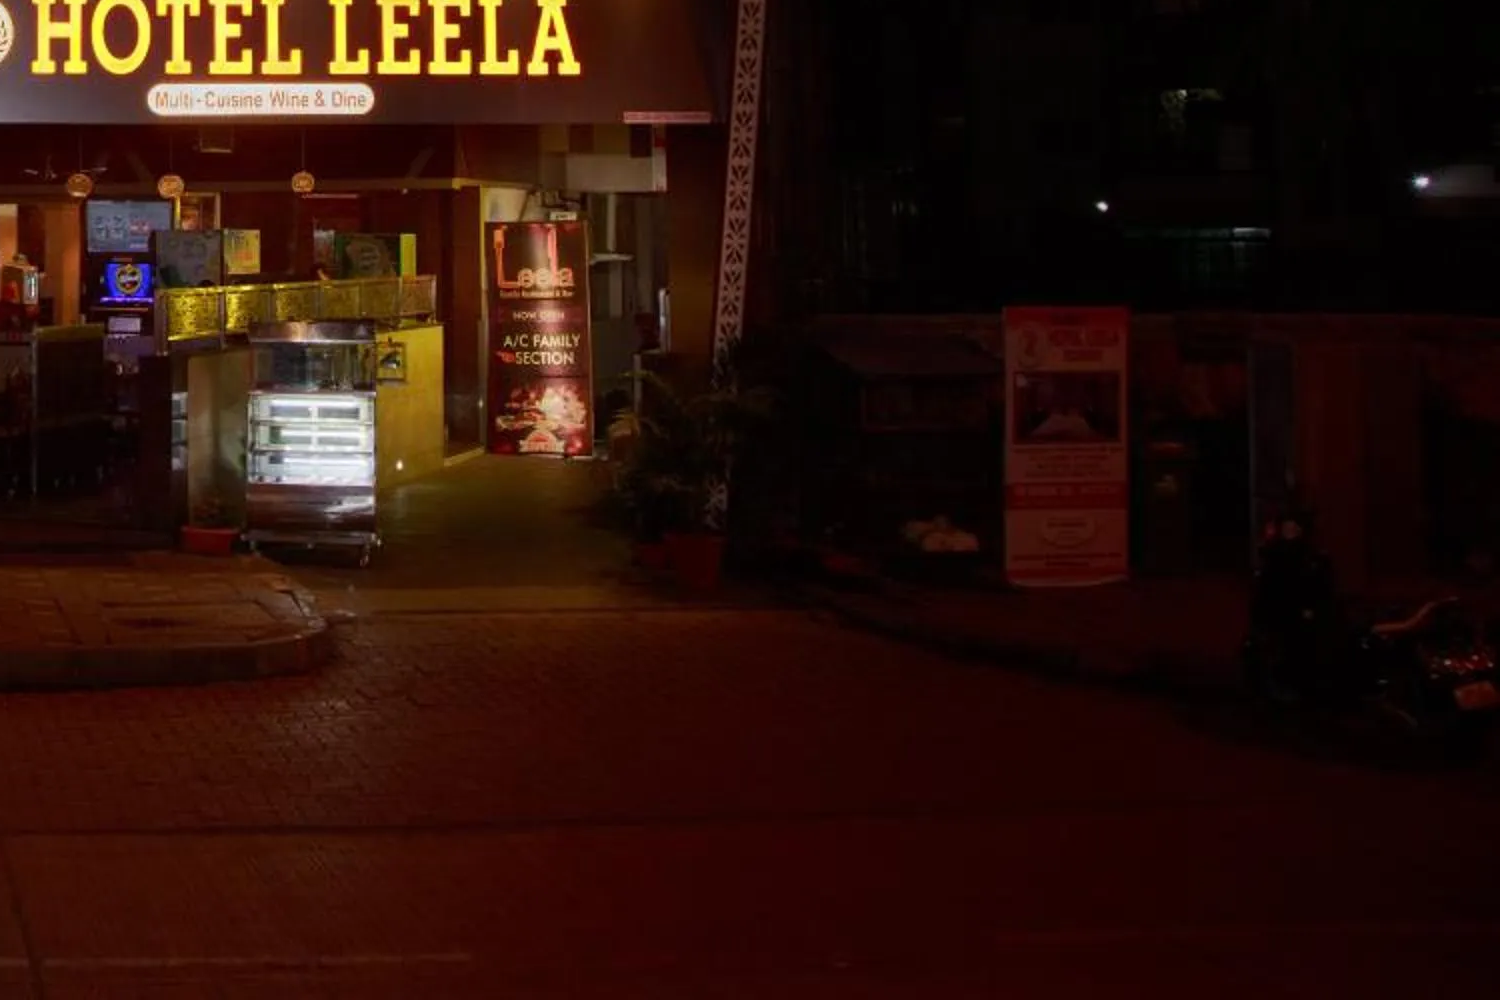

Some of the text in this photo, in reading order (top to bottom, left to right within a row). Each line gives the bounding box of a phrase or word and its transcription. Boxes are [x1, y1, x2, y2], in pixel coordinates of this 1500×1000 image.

[270, 90, 309, 108] Wine
[314, 90, 325, 107] &
[331, 90, 367, 108] Dine
[493, 225, 575, 288] Leela
[503, 333, 581, 348] A/C FAMILY
[515, 351, 575, 365] SECTION
